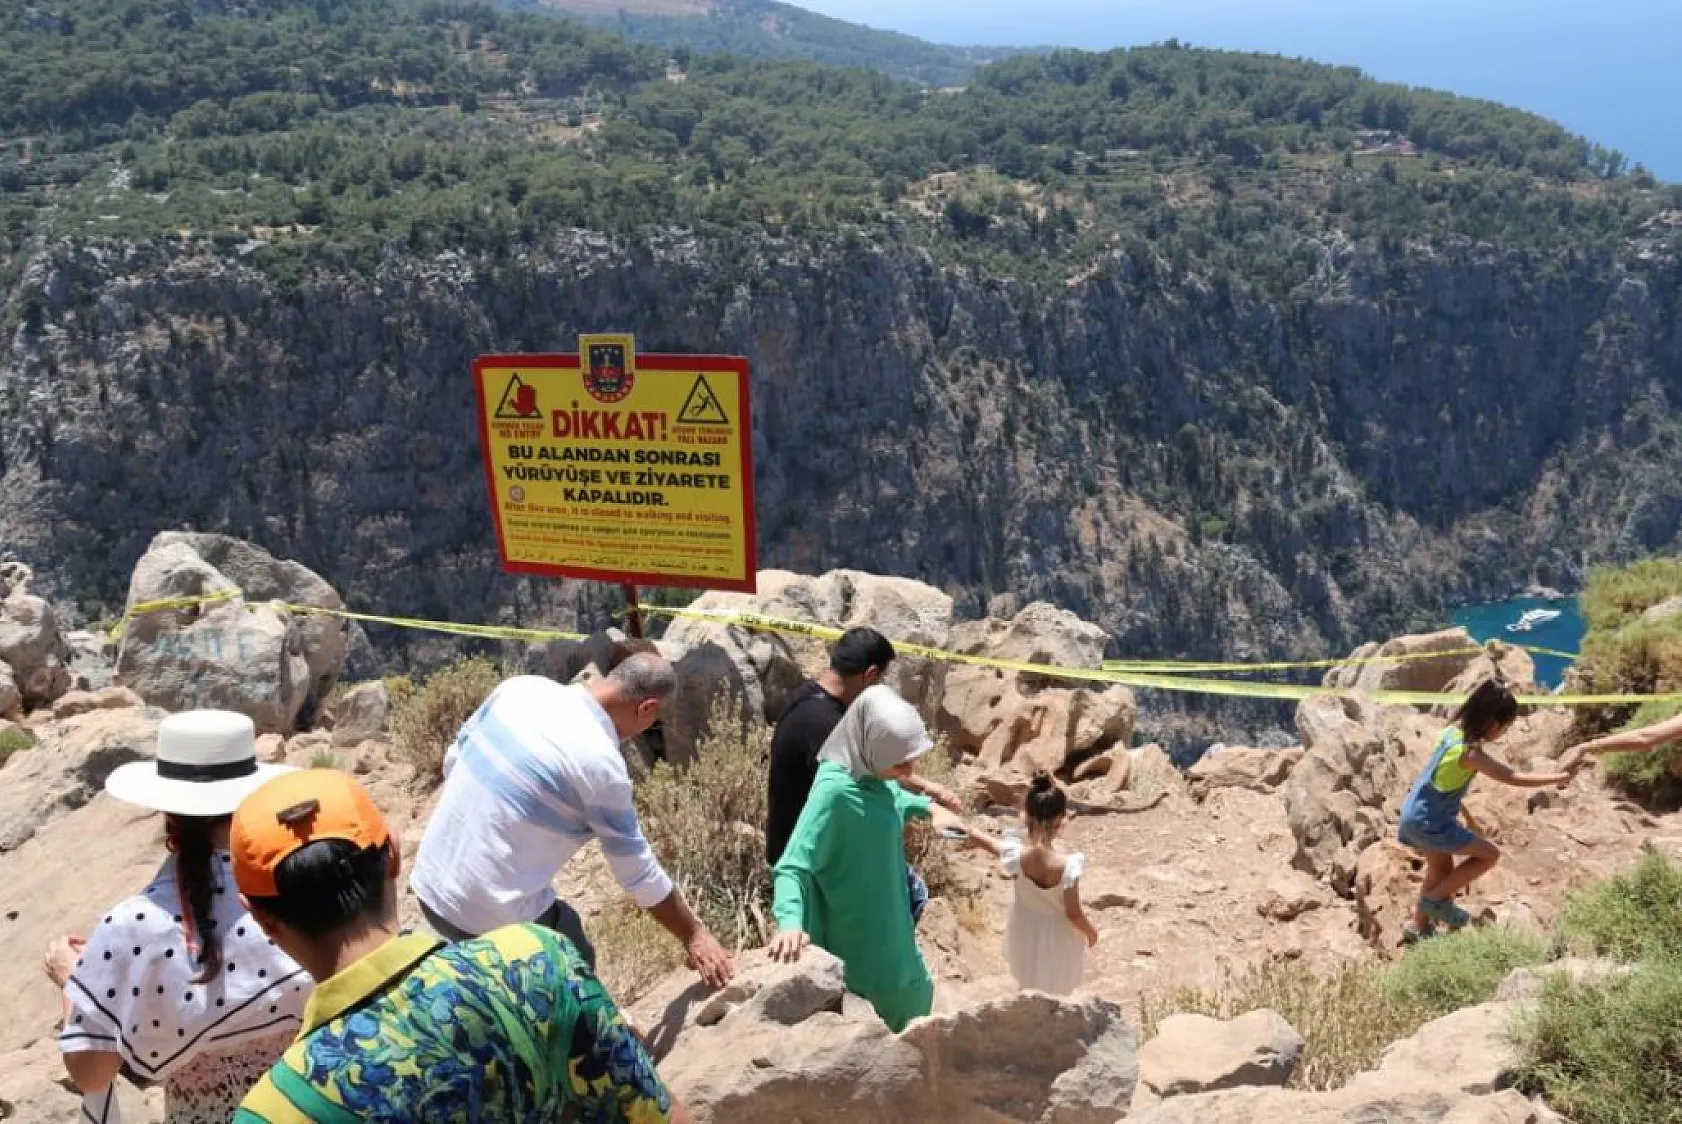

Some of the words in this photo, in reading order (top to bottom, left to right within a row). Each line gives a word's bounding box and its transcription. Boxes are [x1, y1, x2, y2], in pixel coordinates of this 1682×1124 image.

[552, 399, 667, 442] DİKKAT!
[508, 445, 533, 460] BU
[537, 446, 631, 463] ALANDAN
[634, 450, 720, 467] SONRASI
[502, 462, 602, 488] YÜRÜYÜŞE
[605, 469, 631, 485] VE
[635, 466, 731, 489] ZİYARETE
[563, 487, 669, 507] KAPALIDIR.
